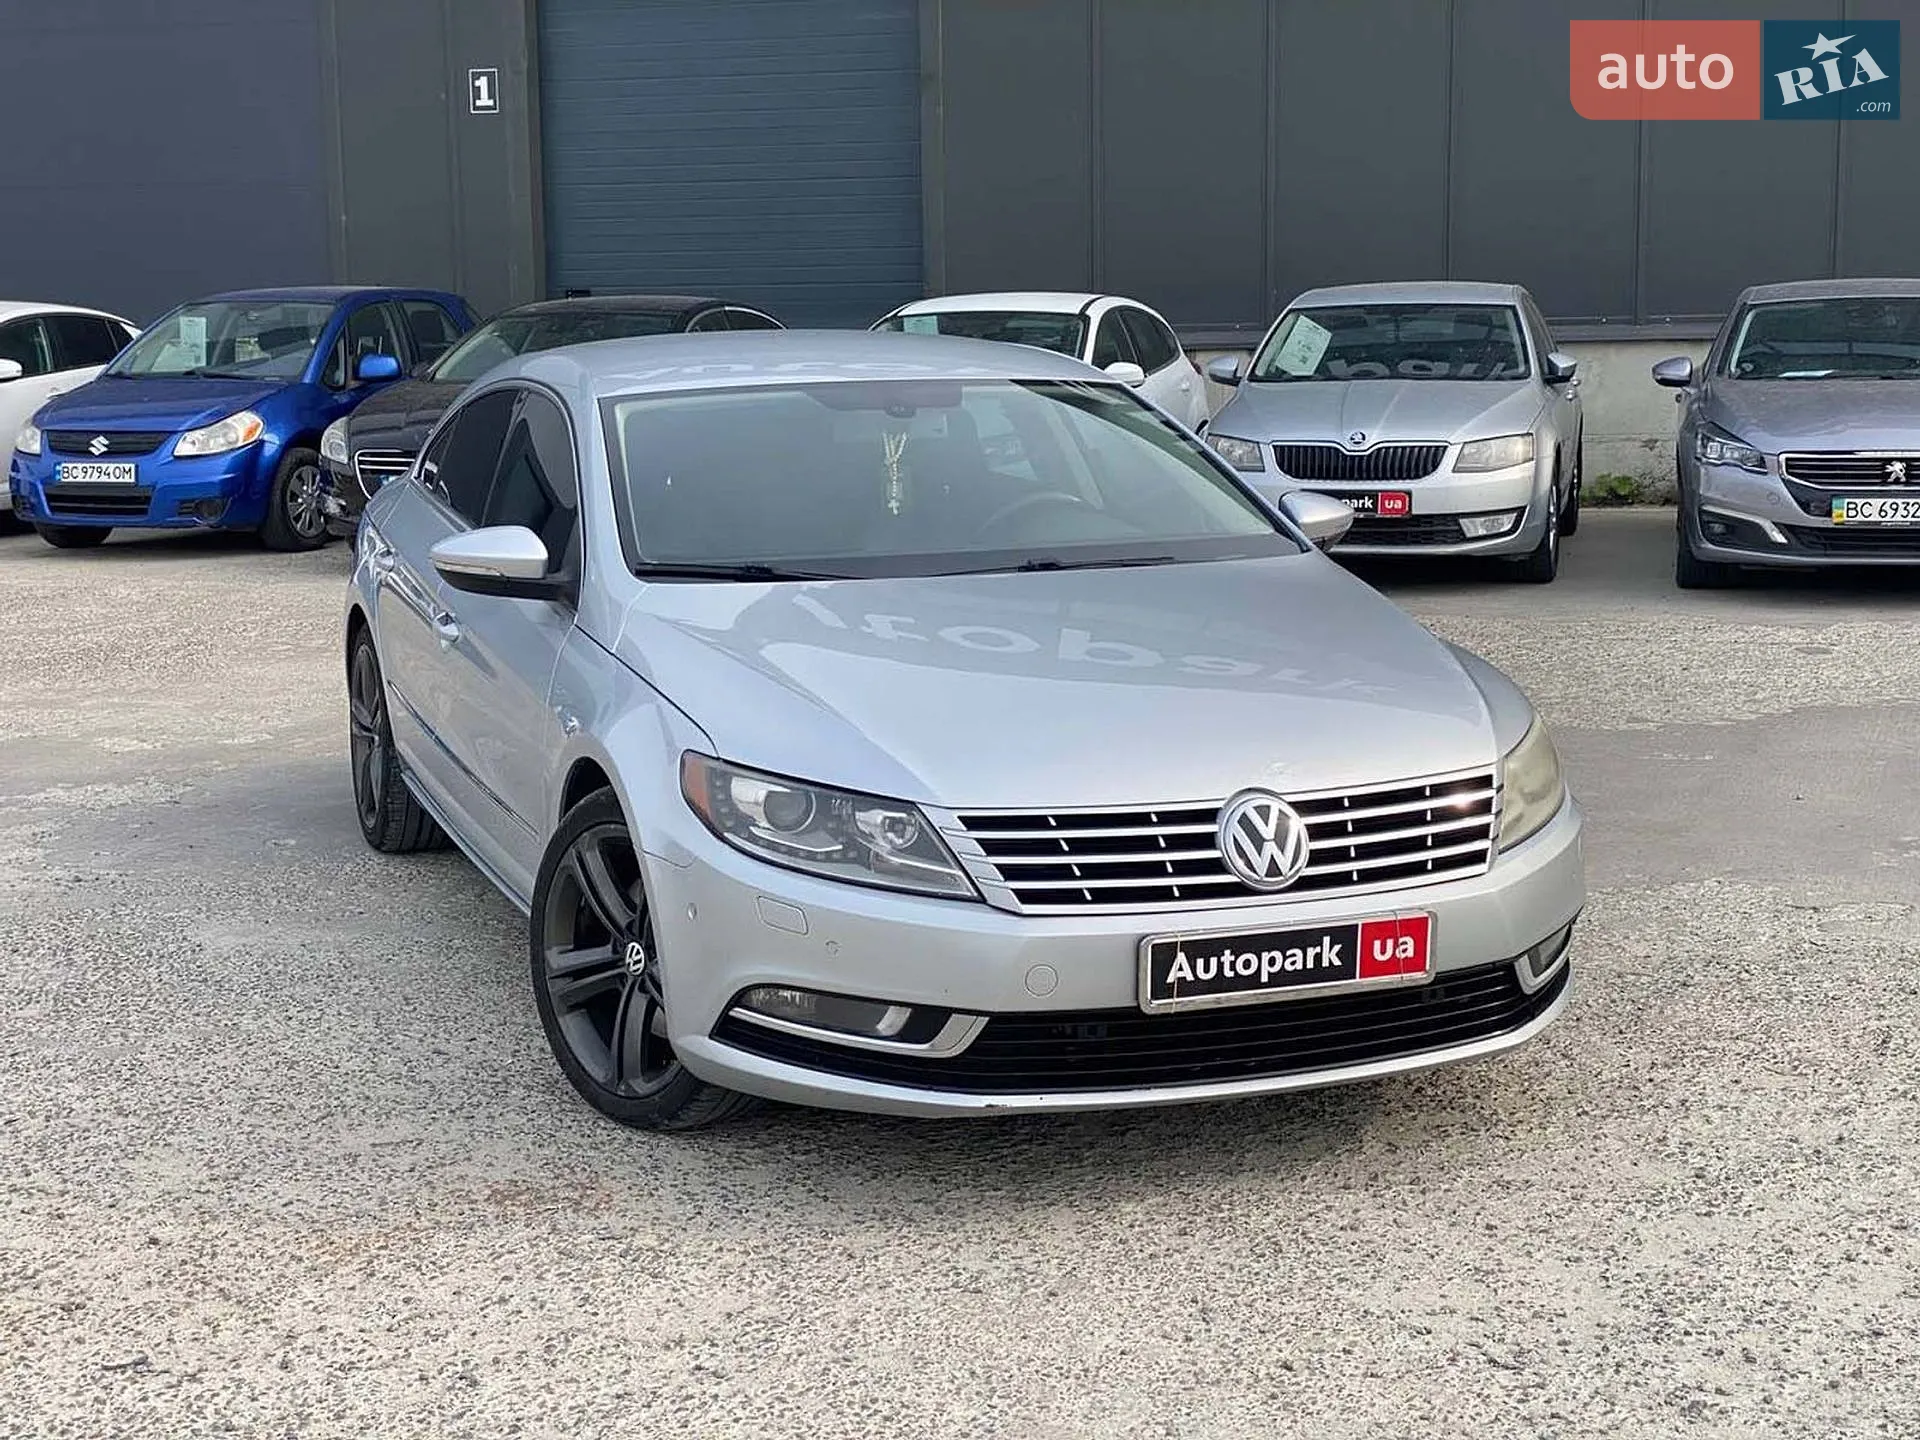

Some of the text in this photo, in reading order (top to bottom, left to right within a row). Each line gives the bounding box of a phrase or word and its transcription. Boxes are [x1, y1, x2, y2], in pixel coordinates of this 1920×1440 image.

[474, 76, 494, 106] 1
[62, 466, 132, 480] BC 9794 OM
[1384, 499, 1402, 509] ua
[1846, 501, 1873, 518] BC
[1878, 501, 1920, 518] 6932
[1166, 935, 1415, 984] Autopark ua
